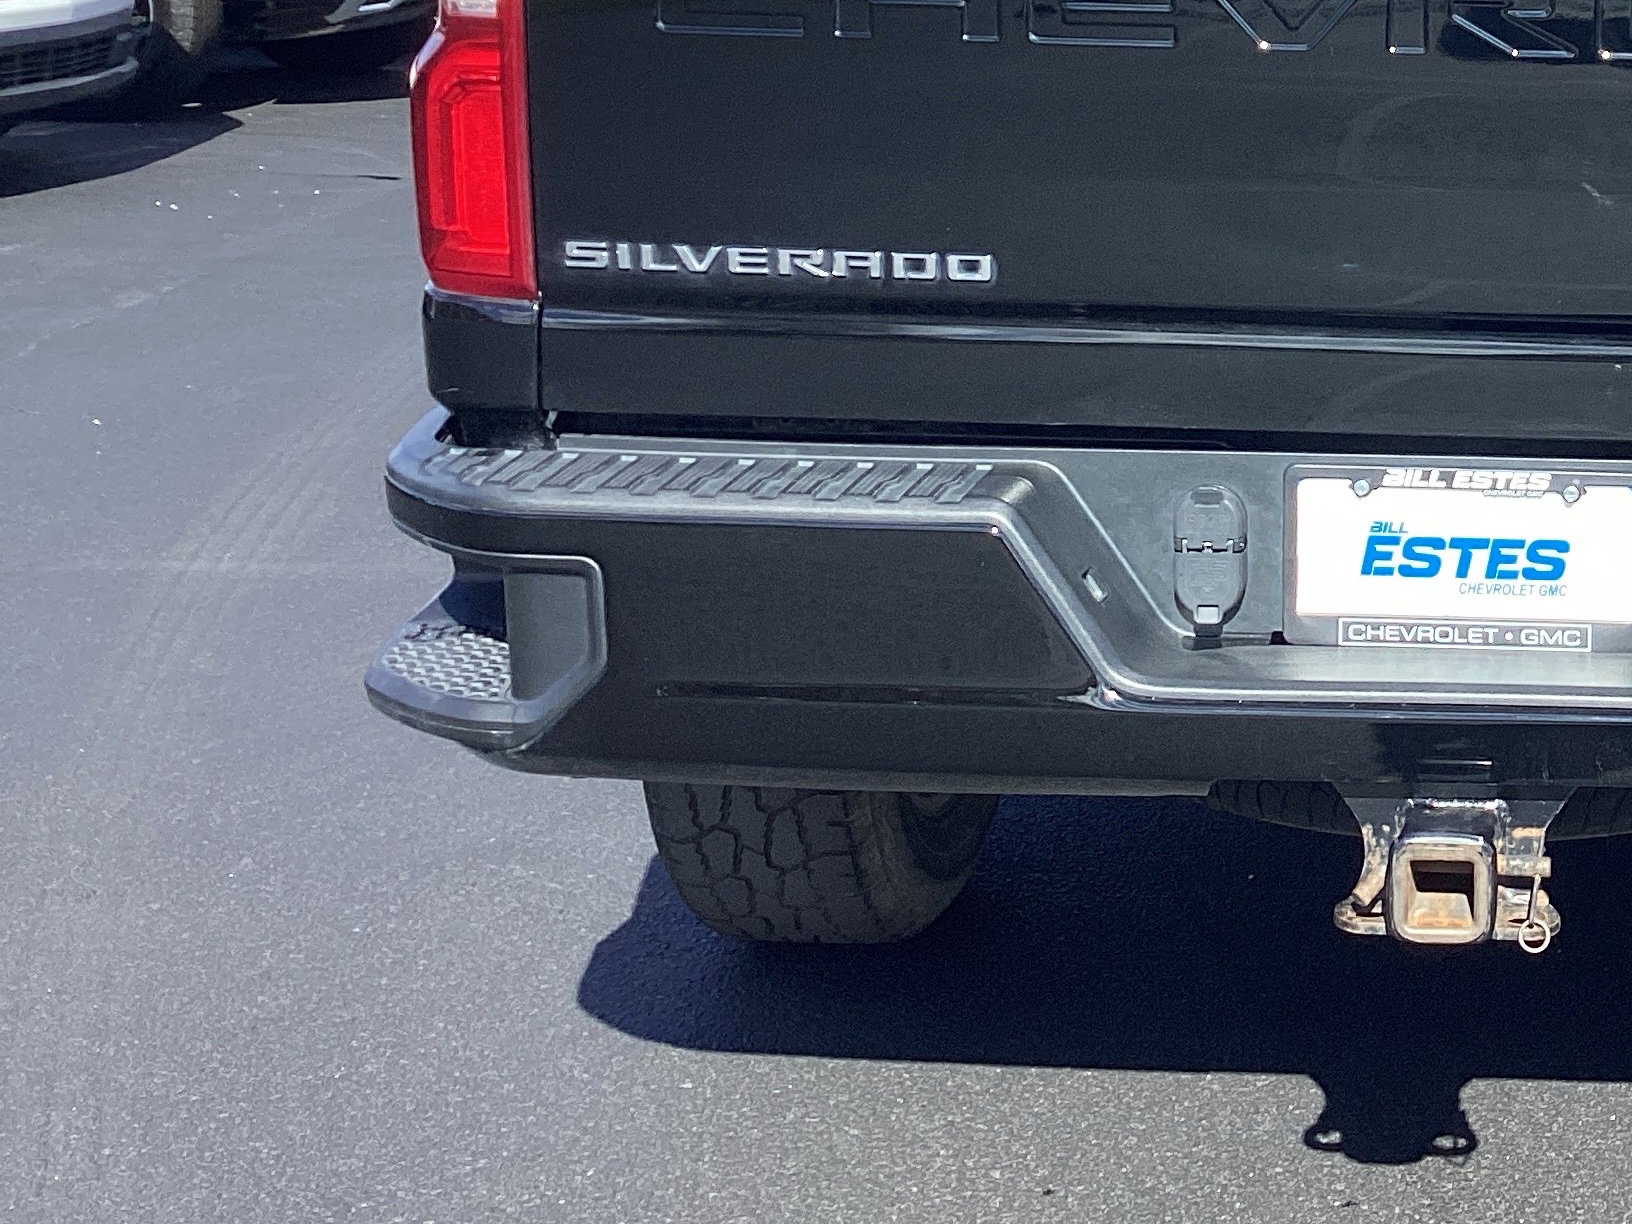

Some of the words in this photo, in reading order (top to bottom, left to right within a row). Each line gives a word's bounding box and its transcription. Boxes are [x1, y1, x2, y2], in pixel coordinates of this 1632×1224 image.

[562, 239, 997, 284] SILVERADO
[1382, 469, 1447, 488] BILL
[1452, 470, 1552, 491] ESTES
[1369, 520, 1409, 534] BILL
[1360, 536, 1571, 581] ESTES
[1459, 582, 1536, 597] CHEVROLET
[1539, 584, 1567, 598] GMC
[1347, 623, 1500, 644] CHEVROLET
[1520, 628, 1582, 647] GMC
